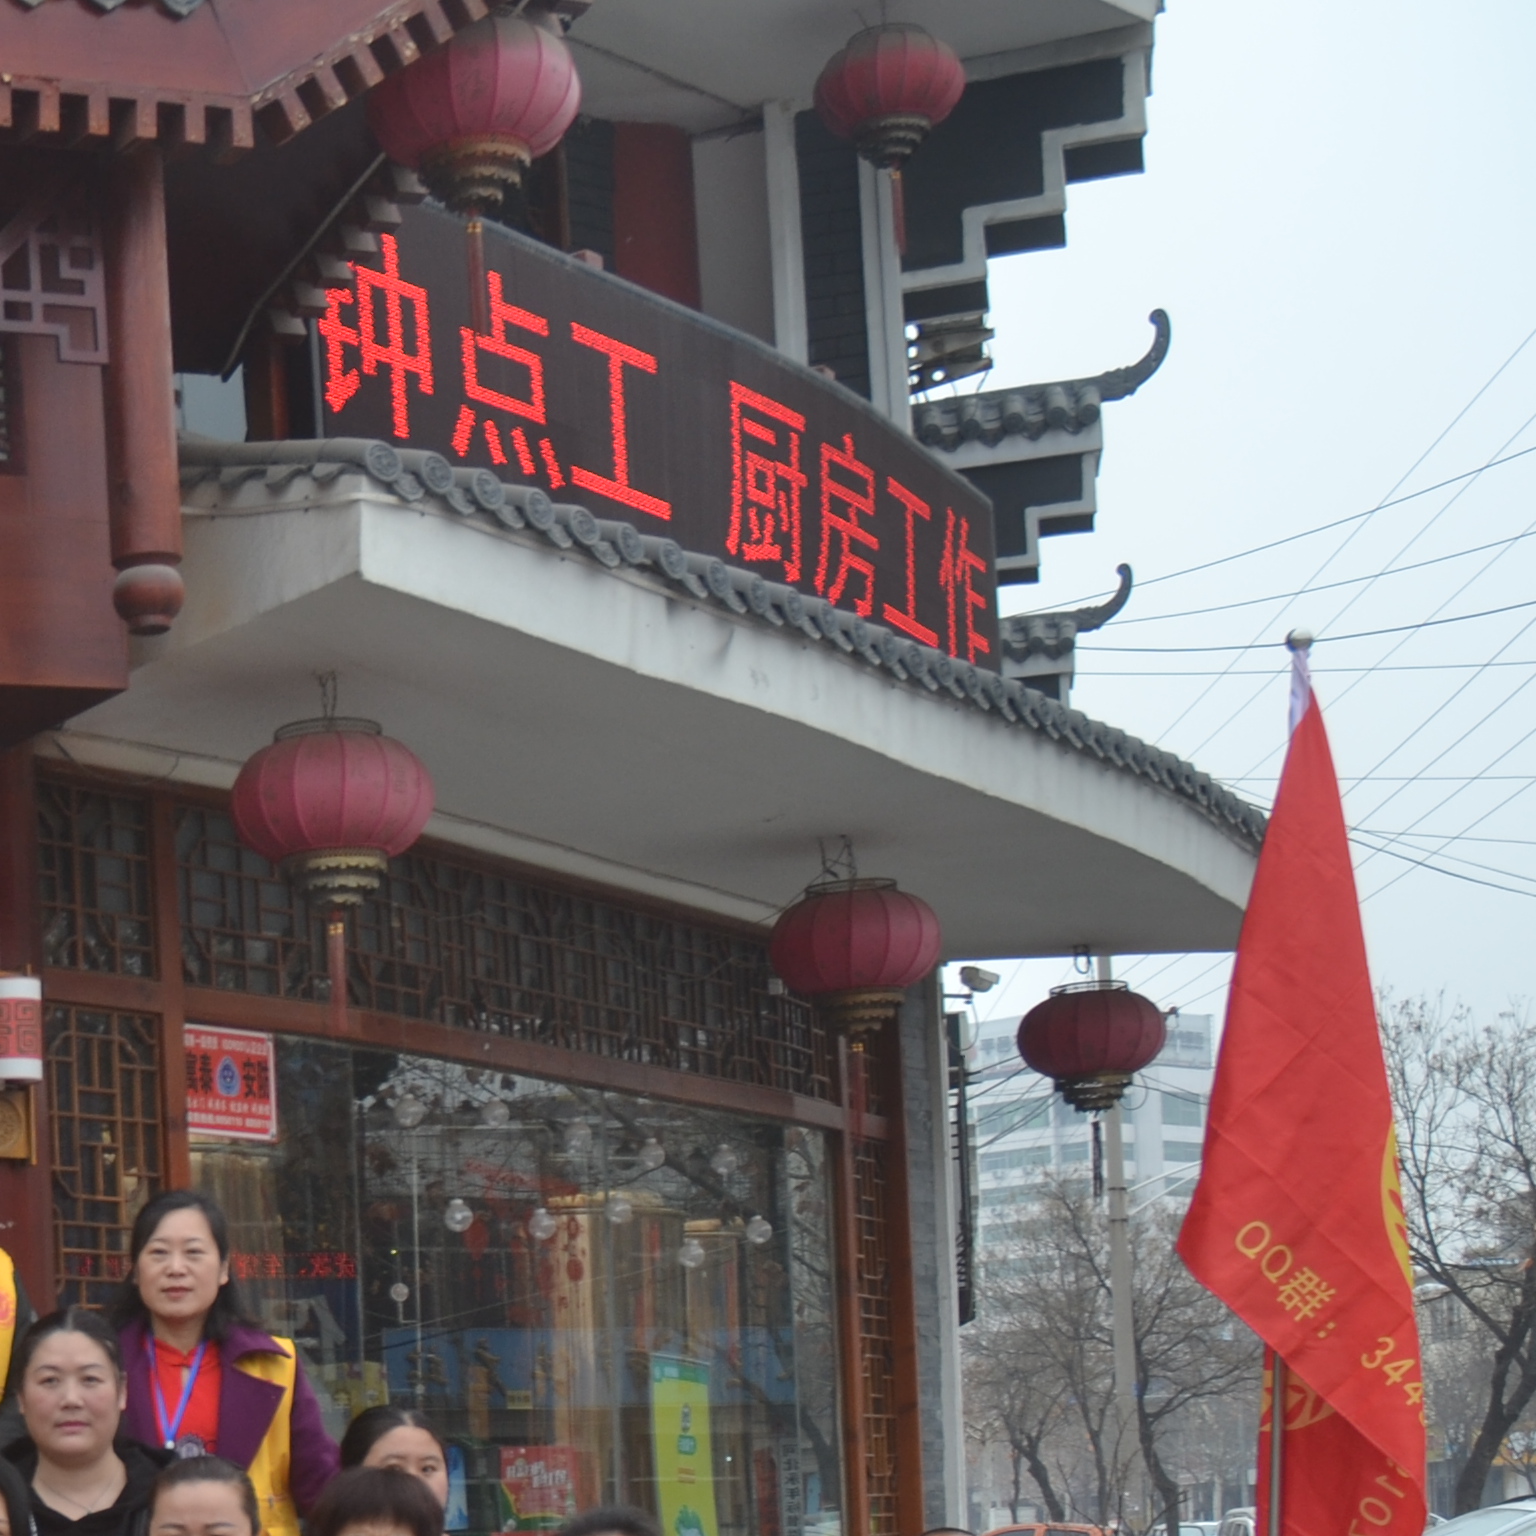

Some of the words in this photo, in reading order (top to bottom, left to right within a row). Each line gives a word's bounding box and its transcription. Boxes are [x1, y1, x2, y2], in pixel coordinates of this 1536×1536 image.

[319, 233, 672, 520] 钟点工
[727, 380, 991, 666] 厨房工作
[1361, 1336, 1427, 1428] 344
